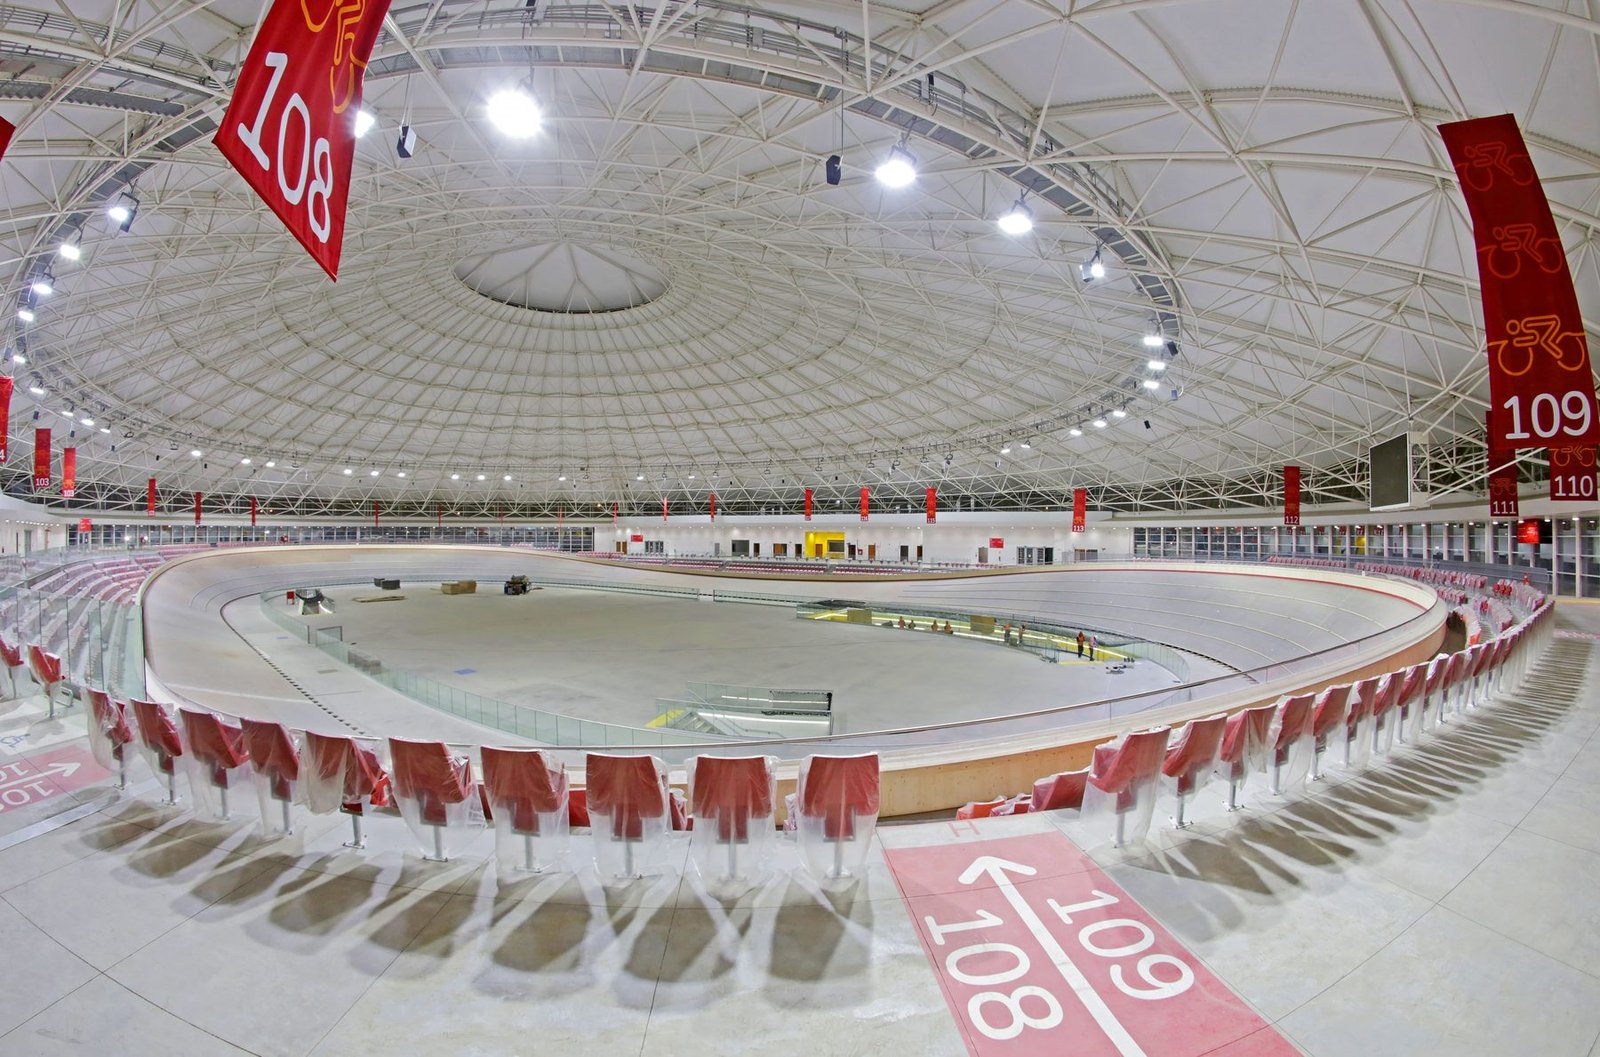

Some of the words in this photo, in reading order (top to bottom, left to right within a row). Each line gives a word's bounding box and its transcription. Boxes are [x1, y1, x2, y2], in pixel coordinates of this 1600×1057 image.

[237, 51, 333, 243] 108
[1503, 390, 1591, 440] 109
[35, 478, 50, 487] 103
[1554, 475, 1593, 497] 110
[1285, 515, 1299, 524] 112
[1493, 500, 1517, 514] 111
[1046, 890, 1195, 1000] 109
[924, 909, 1064, 1041] 108
